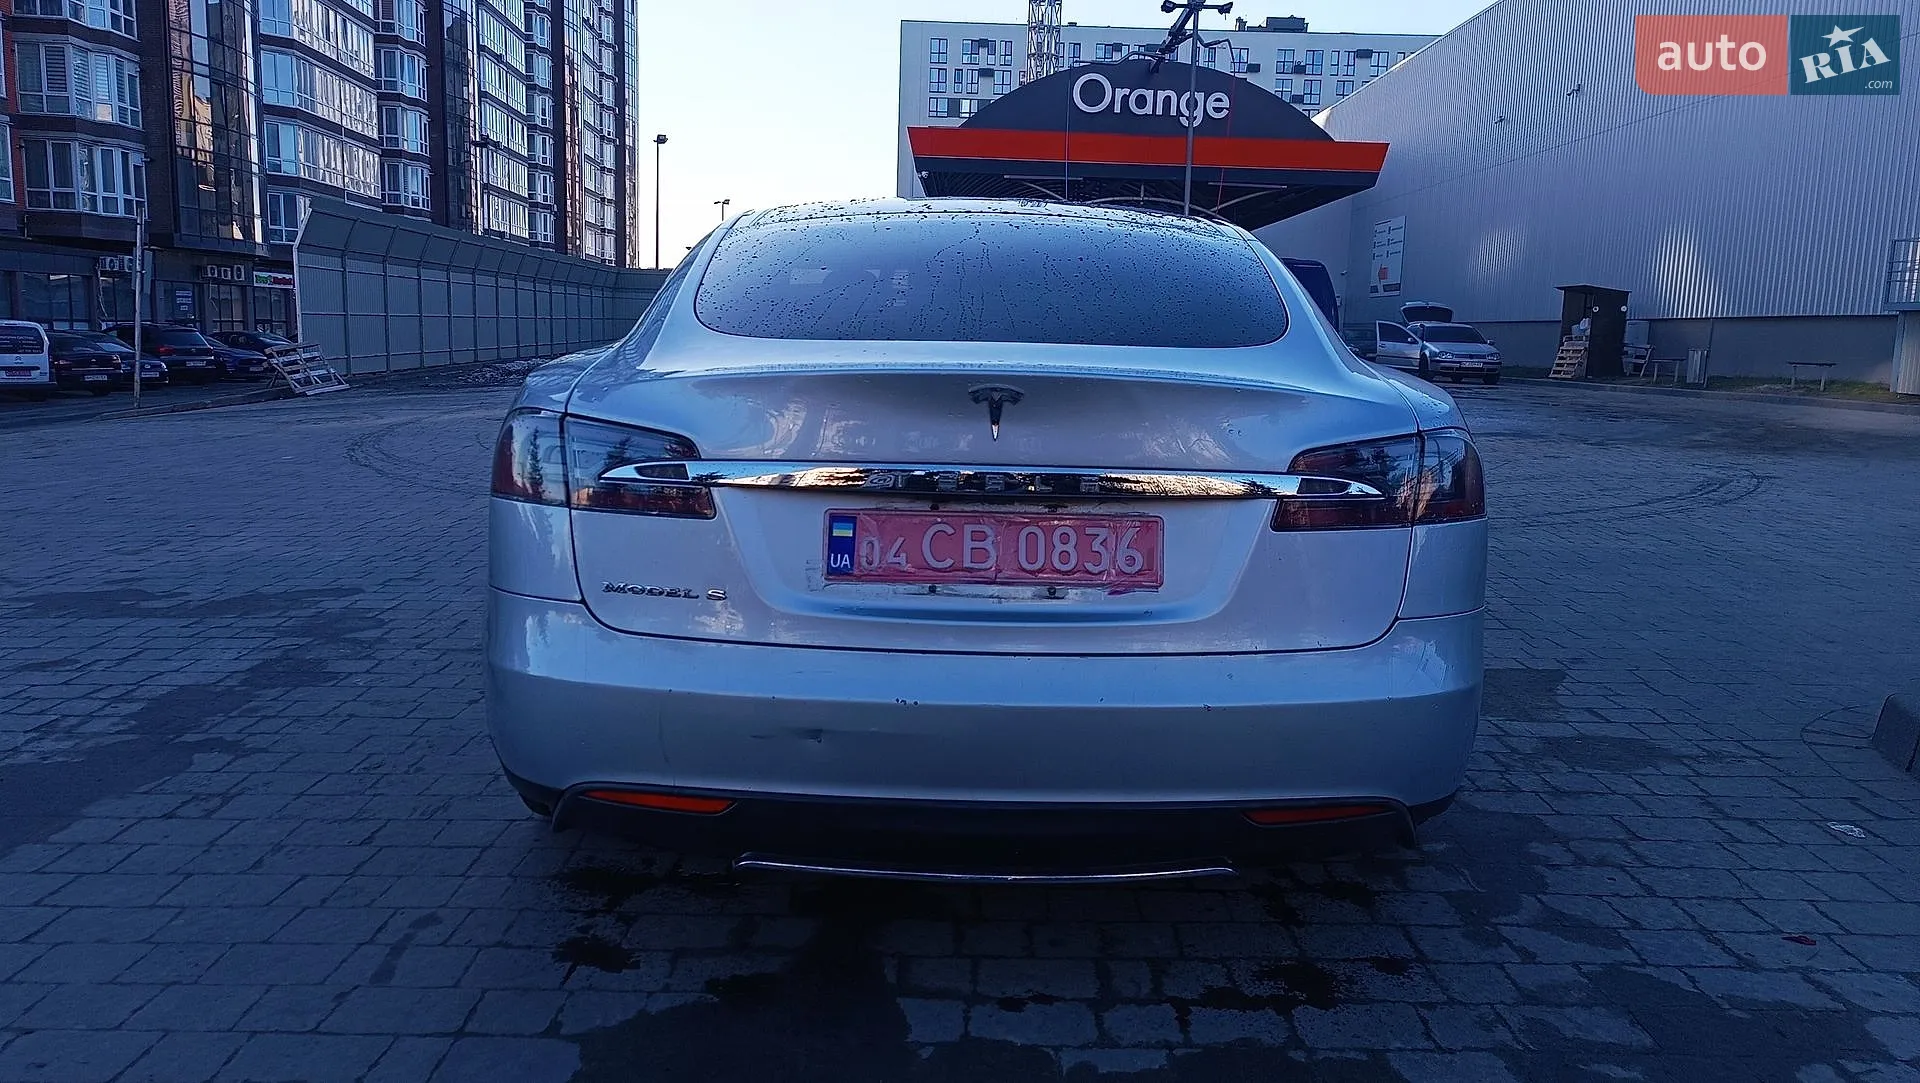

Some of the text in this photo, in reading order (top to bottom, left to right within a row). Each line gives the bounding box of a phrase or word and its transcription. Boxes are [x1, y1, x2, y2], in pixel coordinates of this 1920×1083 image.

[1072, 72, 1231, 128] Orange
[830, 553, 851, 568] UA
[859, 523, 1145, 575] 04 CB 0836
[601, 581, 728, 601] MODEL S
